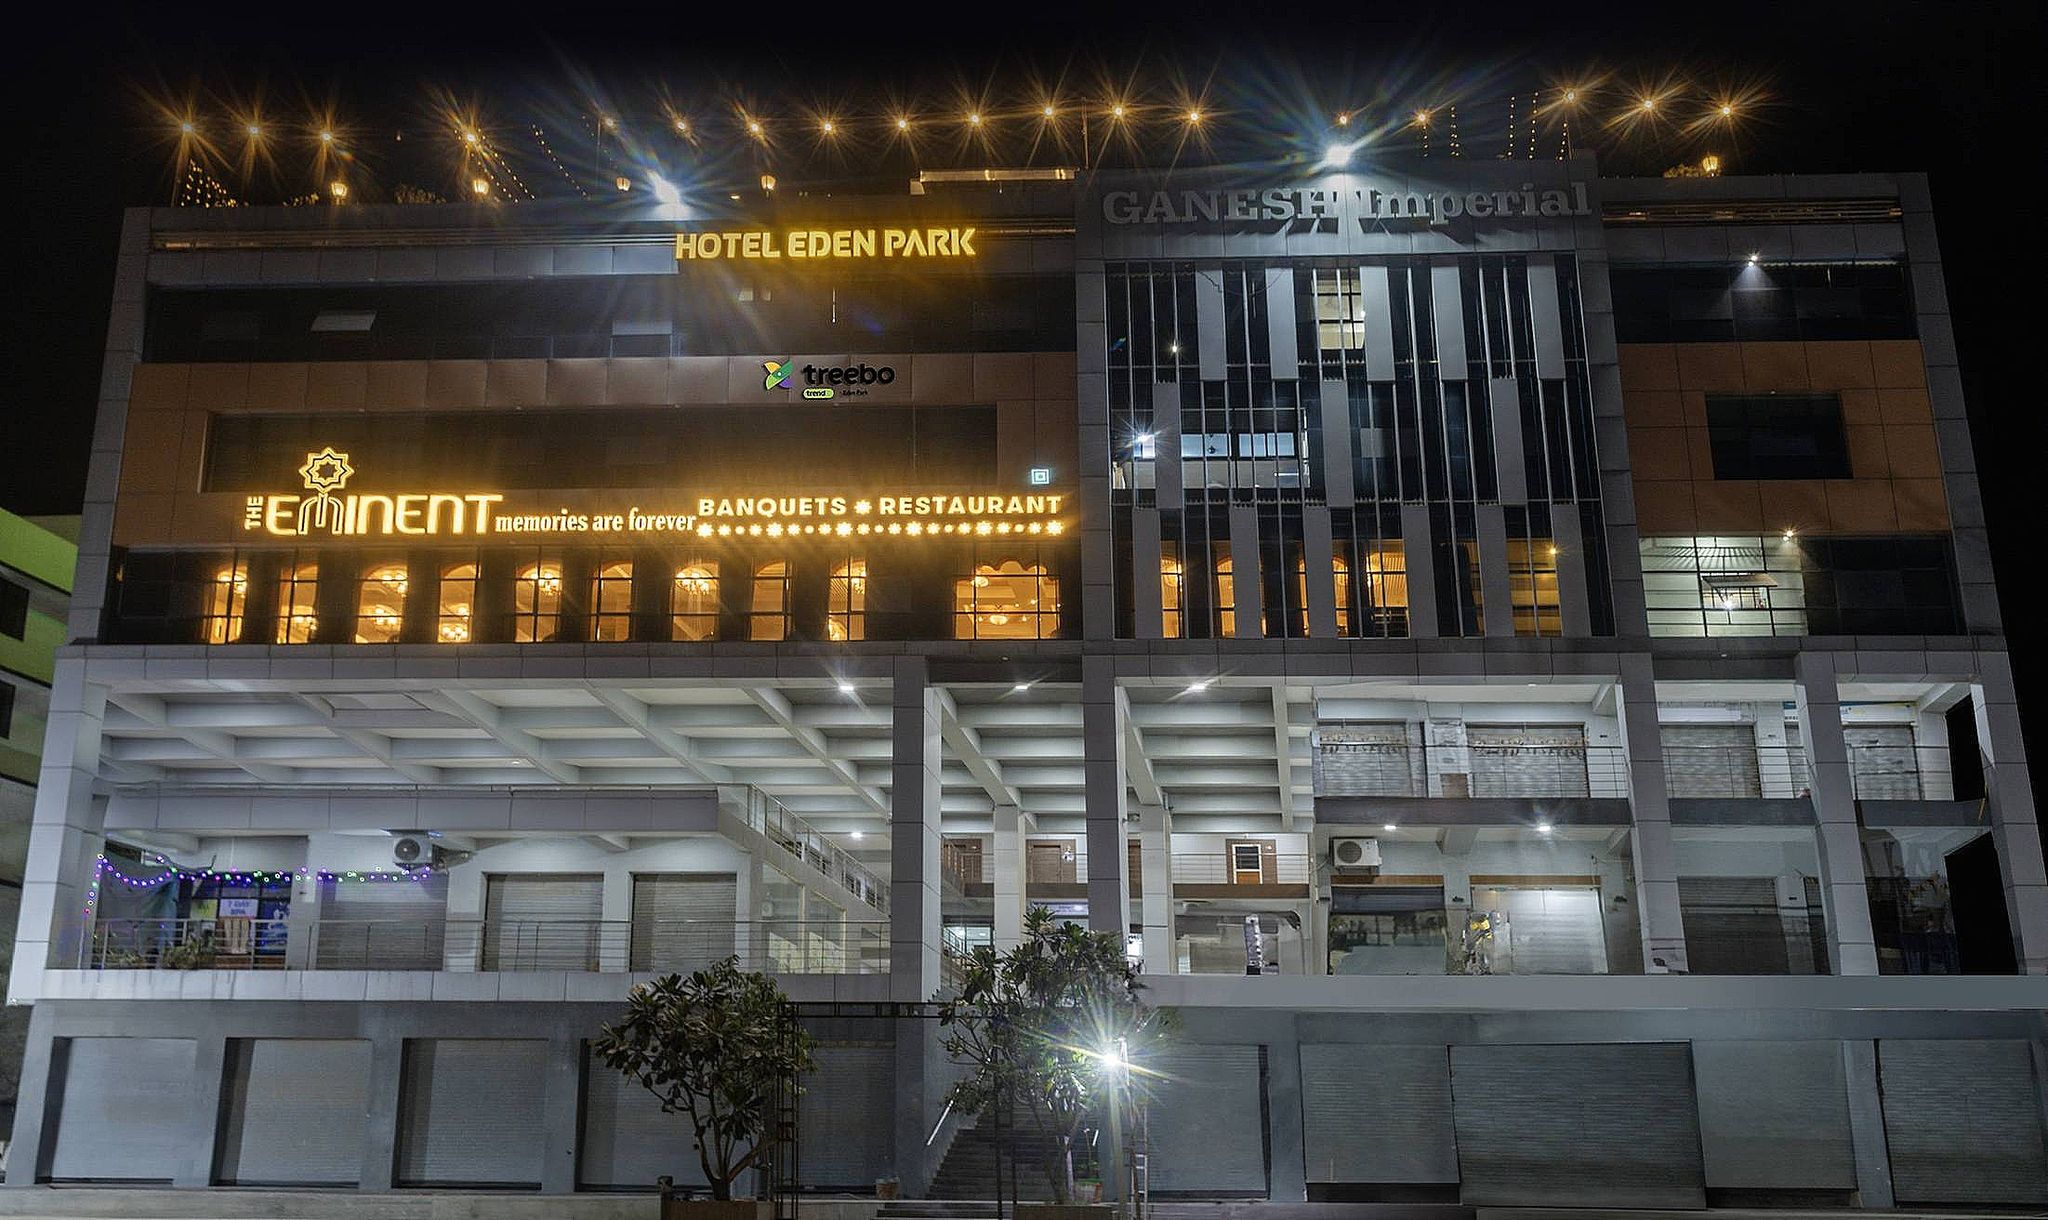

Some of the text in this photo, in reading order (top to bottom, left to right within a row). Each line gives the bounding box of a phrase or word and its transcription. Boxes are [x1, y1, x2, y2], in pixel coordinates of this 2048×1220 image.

[1103, 182, 1591, 225] GANESH Imperial
[676, 228, 976, 259] HOTEL EDEN PARK
[802, 363, 895, 385] treebo
[244, 496, 264, 530] THE
[495, 507, 697, 532] memories are forever
[699, 495, 1062, 516] BANQUETS RESTAURANT
